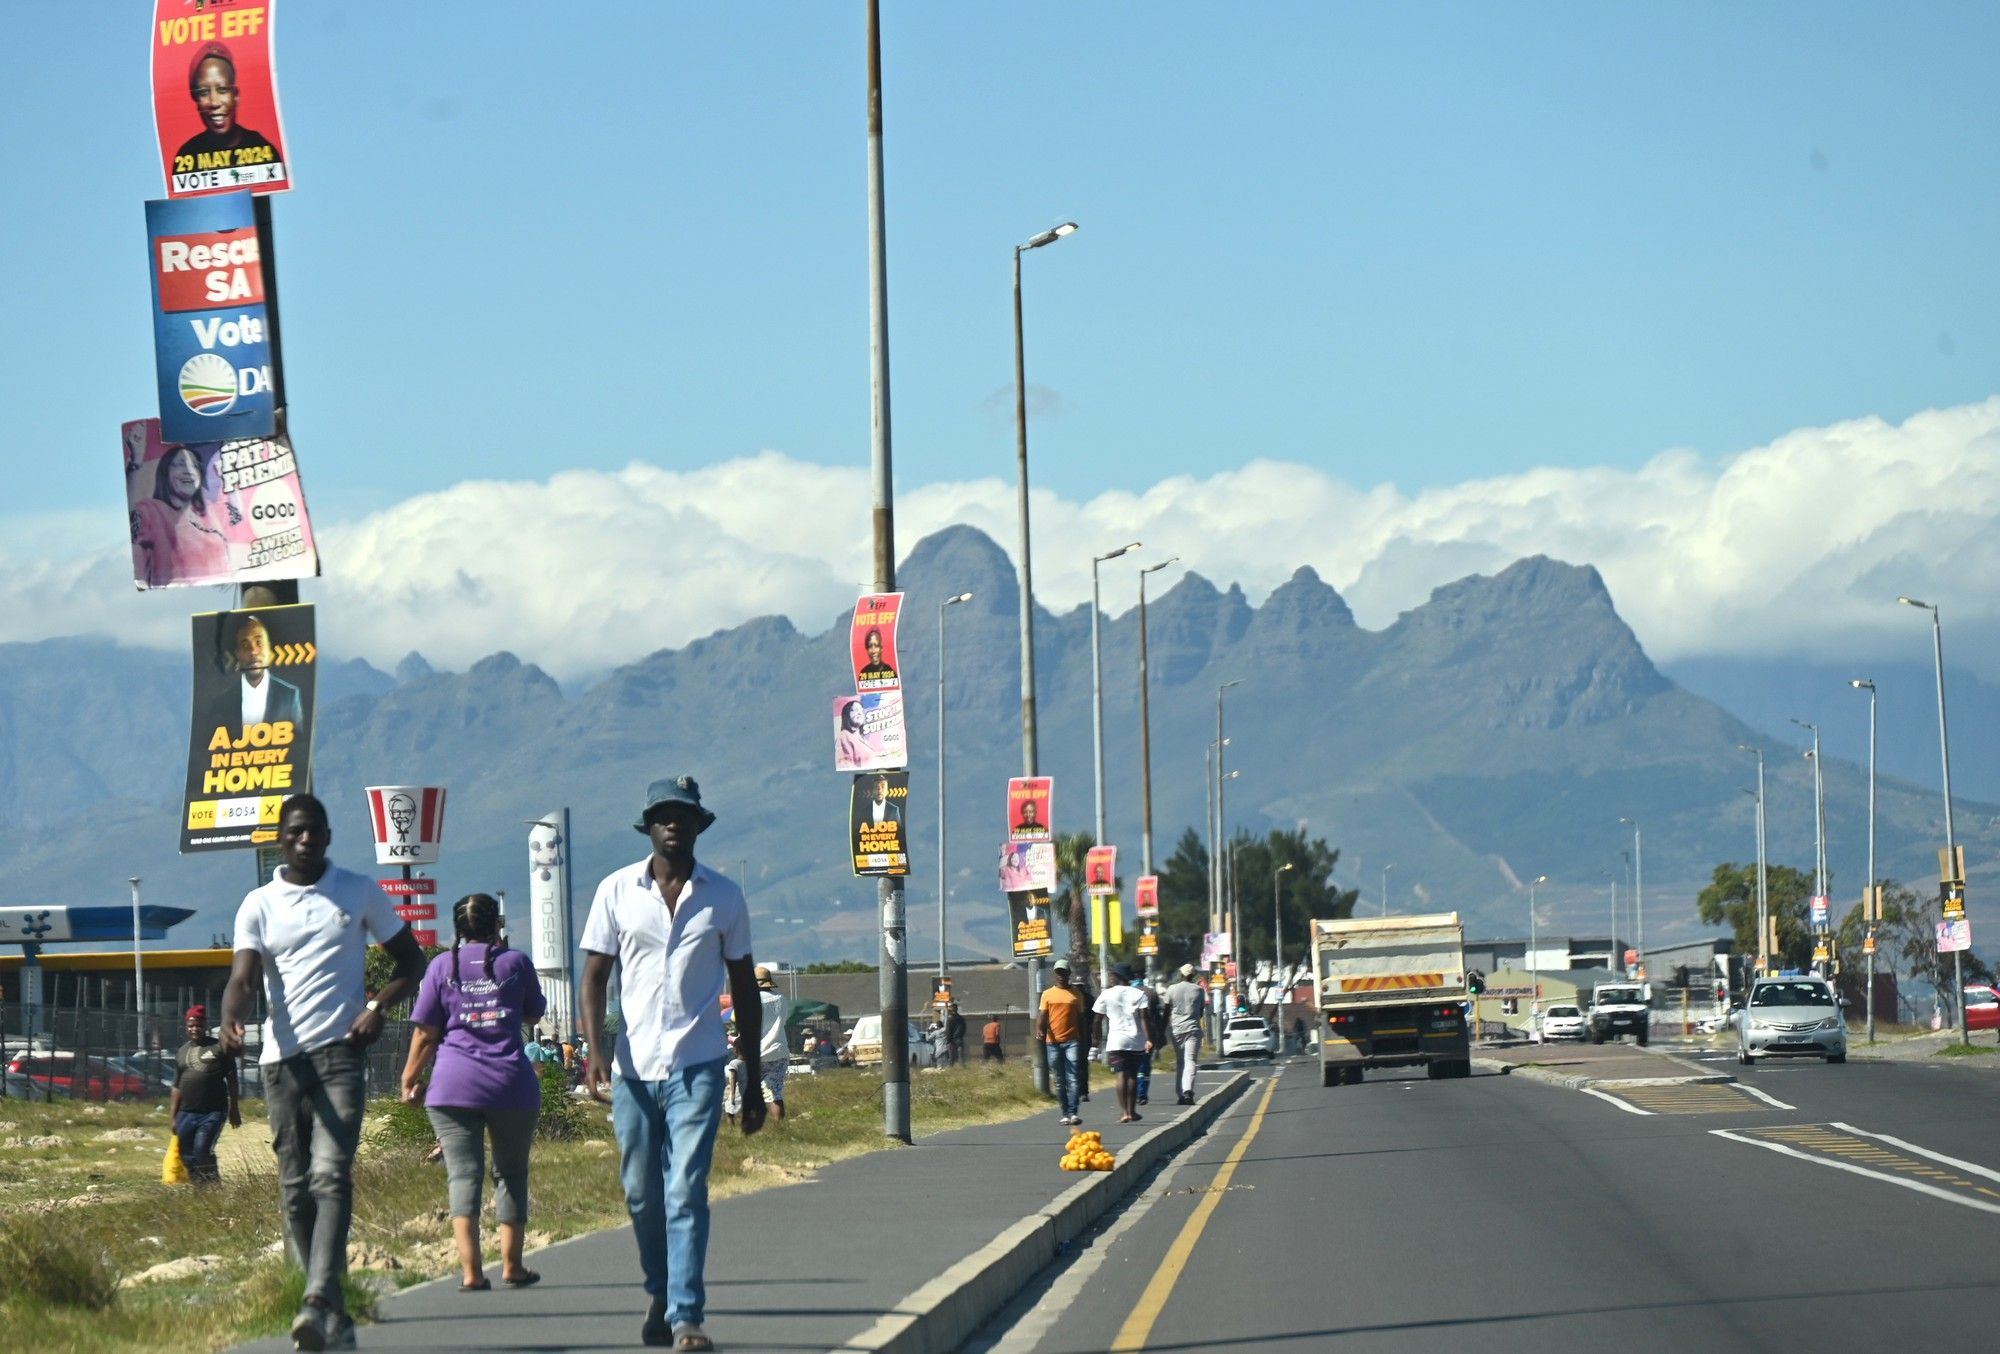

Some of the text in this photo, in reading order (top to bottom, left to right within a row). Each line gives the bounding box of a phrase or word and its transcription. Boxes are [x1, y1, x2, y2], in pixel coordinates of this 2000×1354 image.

[160, 7, 265, 46] VOTE EFF
[175, 145, 273, 172] 29 MAY 2024
[176, 171, 219, 189] VOTE
[205, 268, 253, 302] SA
[190, 314, 263, 349] Vote
[238, 364, 273, 396] DA
[252, 502, 296, 520] GOOD
[855, 611, 896, 627] VOTE EFF
[861, 680, 876, 688] VOTE
[208, 720, 295, 751] A JOB
[211, 748, 290, 768] IN EVERY
[203, 764, 294, 794] HOME
[191, 810, 214, 820] VOTE
[228, 806, 256, 818] BOSA
[859, 821, 897, 833] A JOB
[871, 832, 896, 841] EVERY
[389, 845, 421, 857] KFC
[395, 883, 429, 891] HOURS
[855, 1047, 882, 1055] NISSA
